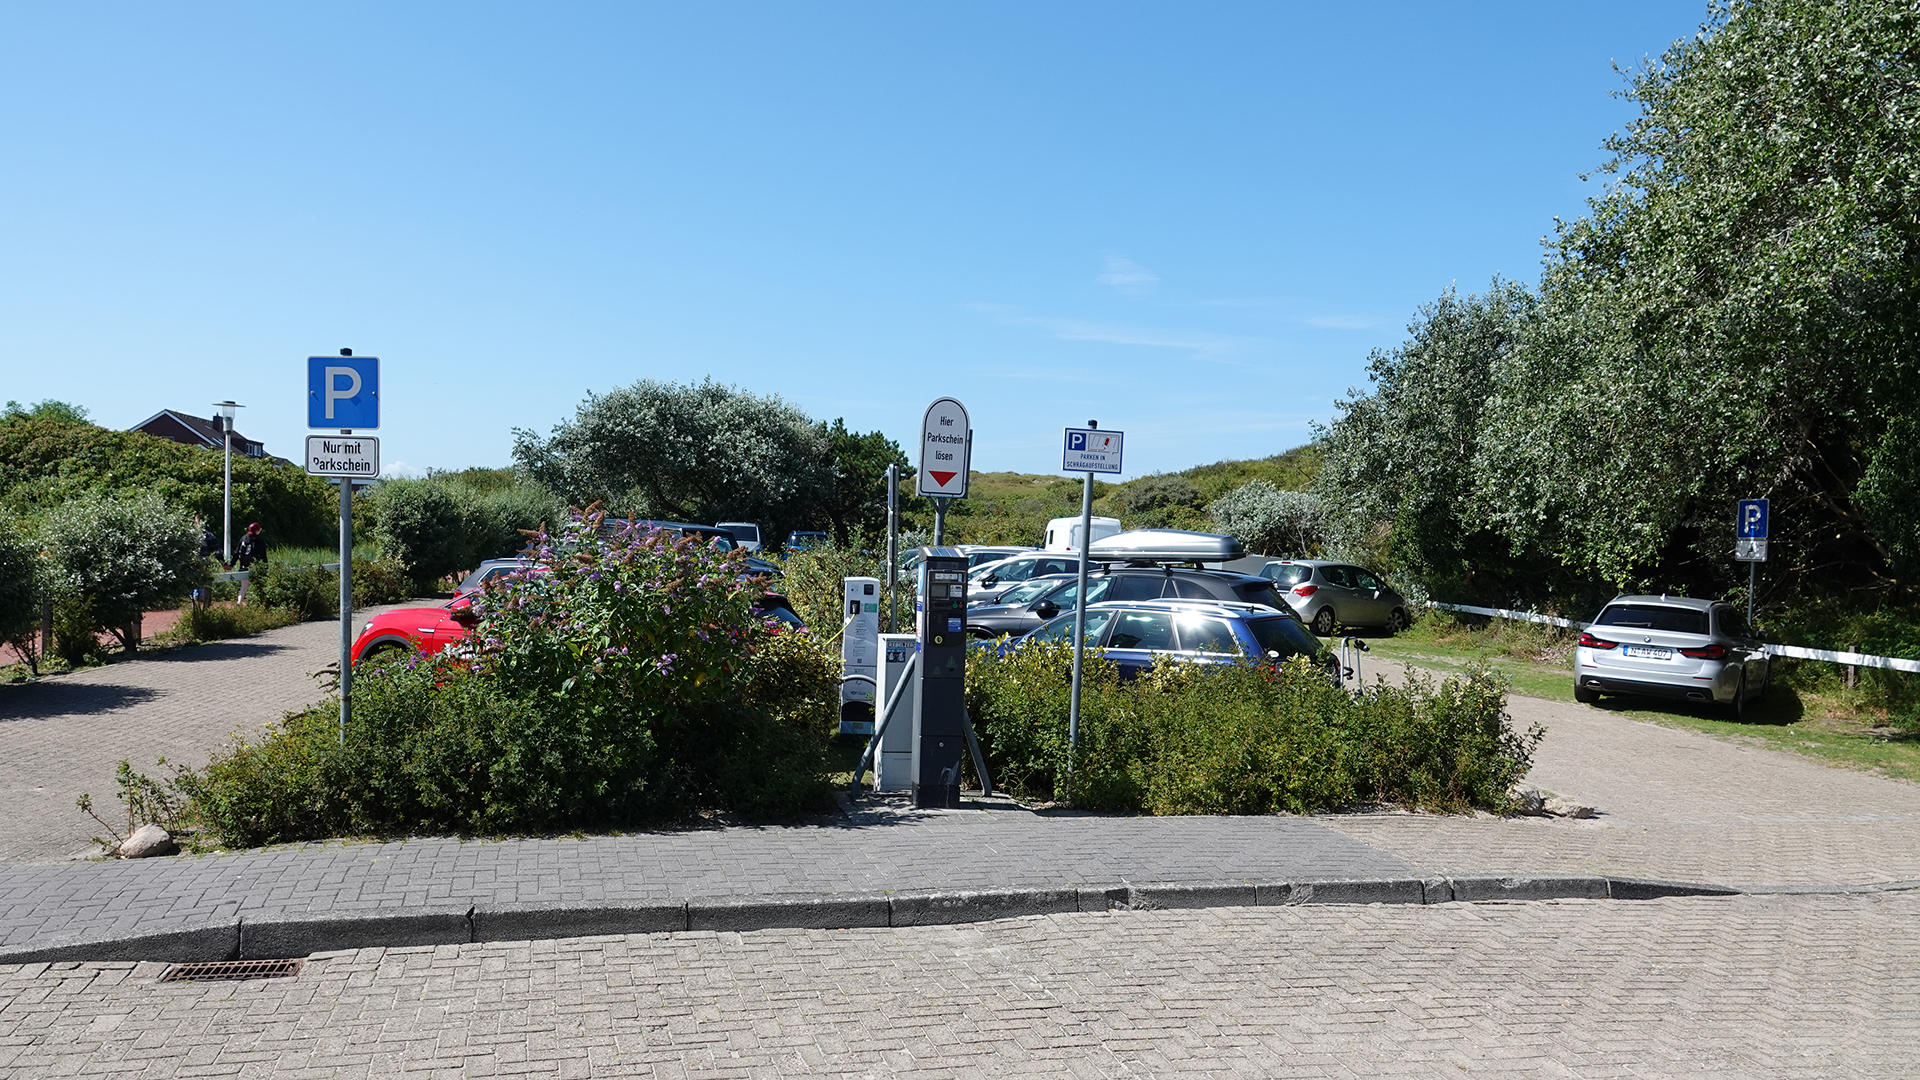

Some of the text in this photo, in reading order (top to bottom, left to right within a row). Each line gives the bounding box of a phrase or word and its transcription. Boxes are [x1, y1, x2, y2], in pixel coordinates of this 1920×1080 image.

[325, 366, 362, 419] P
[940, 416, 954, 427] Hier
[927, 432, 964, 444] Parkschein
[1072, 434, 1083, 449] P
[323, 440, 361, 454] Nur mit
[935, 450, 953, 461] lösen
[1744, 504, 1761, 533] P
